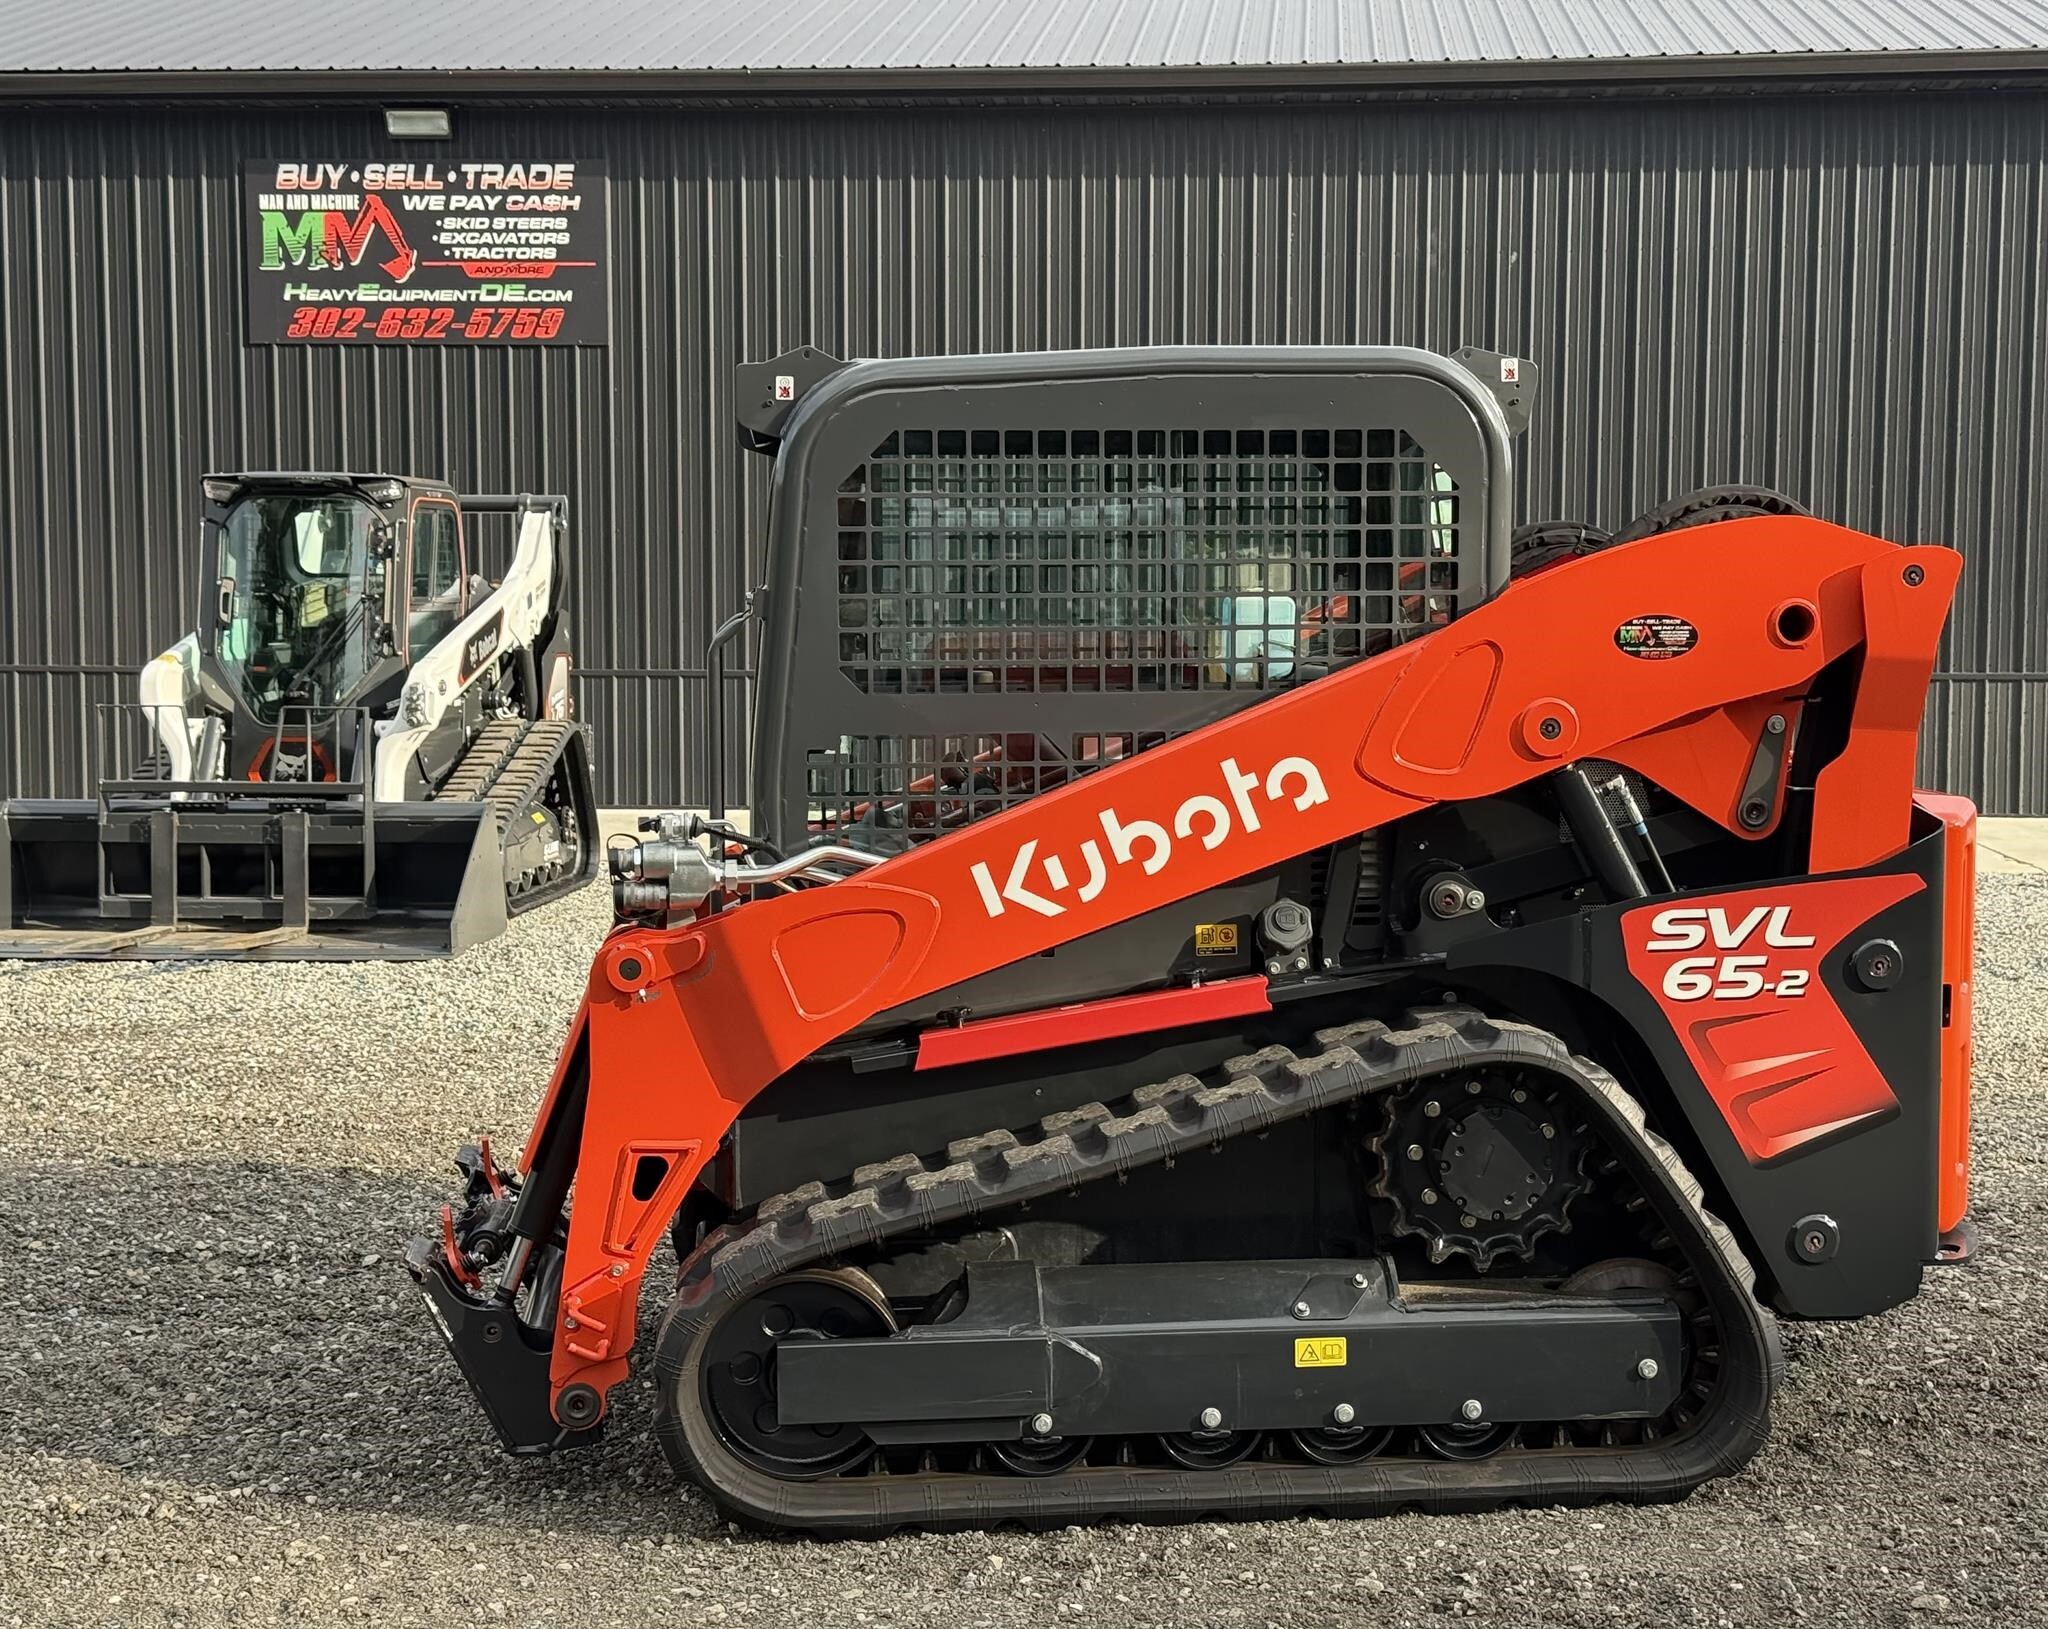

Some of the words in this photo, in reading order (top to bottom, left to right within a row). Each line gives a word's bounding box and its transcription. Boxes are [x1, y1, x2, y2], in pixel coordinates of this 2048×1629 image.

[275, 163, 349, 190] BUY
[362, 163, 444, 190] SELL
[461, 163, 575, 190] TRADE
[258, 194, 284, 210] MAN
[286, 194, 308, 210] AND
[311, 194, 360, 210] MACHINE
[402, 194, 446, 211] WE
[450, 194, 502, 211] PAY
[443, 217, 490, 230] SKID
[492, 217, 568, 230] STEERS
[439, 232, 571, 245] EXCAVATORS
[451, 247, 558, 260] TRACTORS
[287, 306, 565, 338] 302-632-5759
[969, 756, 1330, 919] Kubota
[1645, 905, 1816, 951] SVL
[1661, 955, 1810, 1001] 65-2
